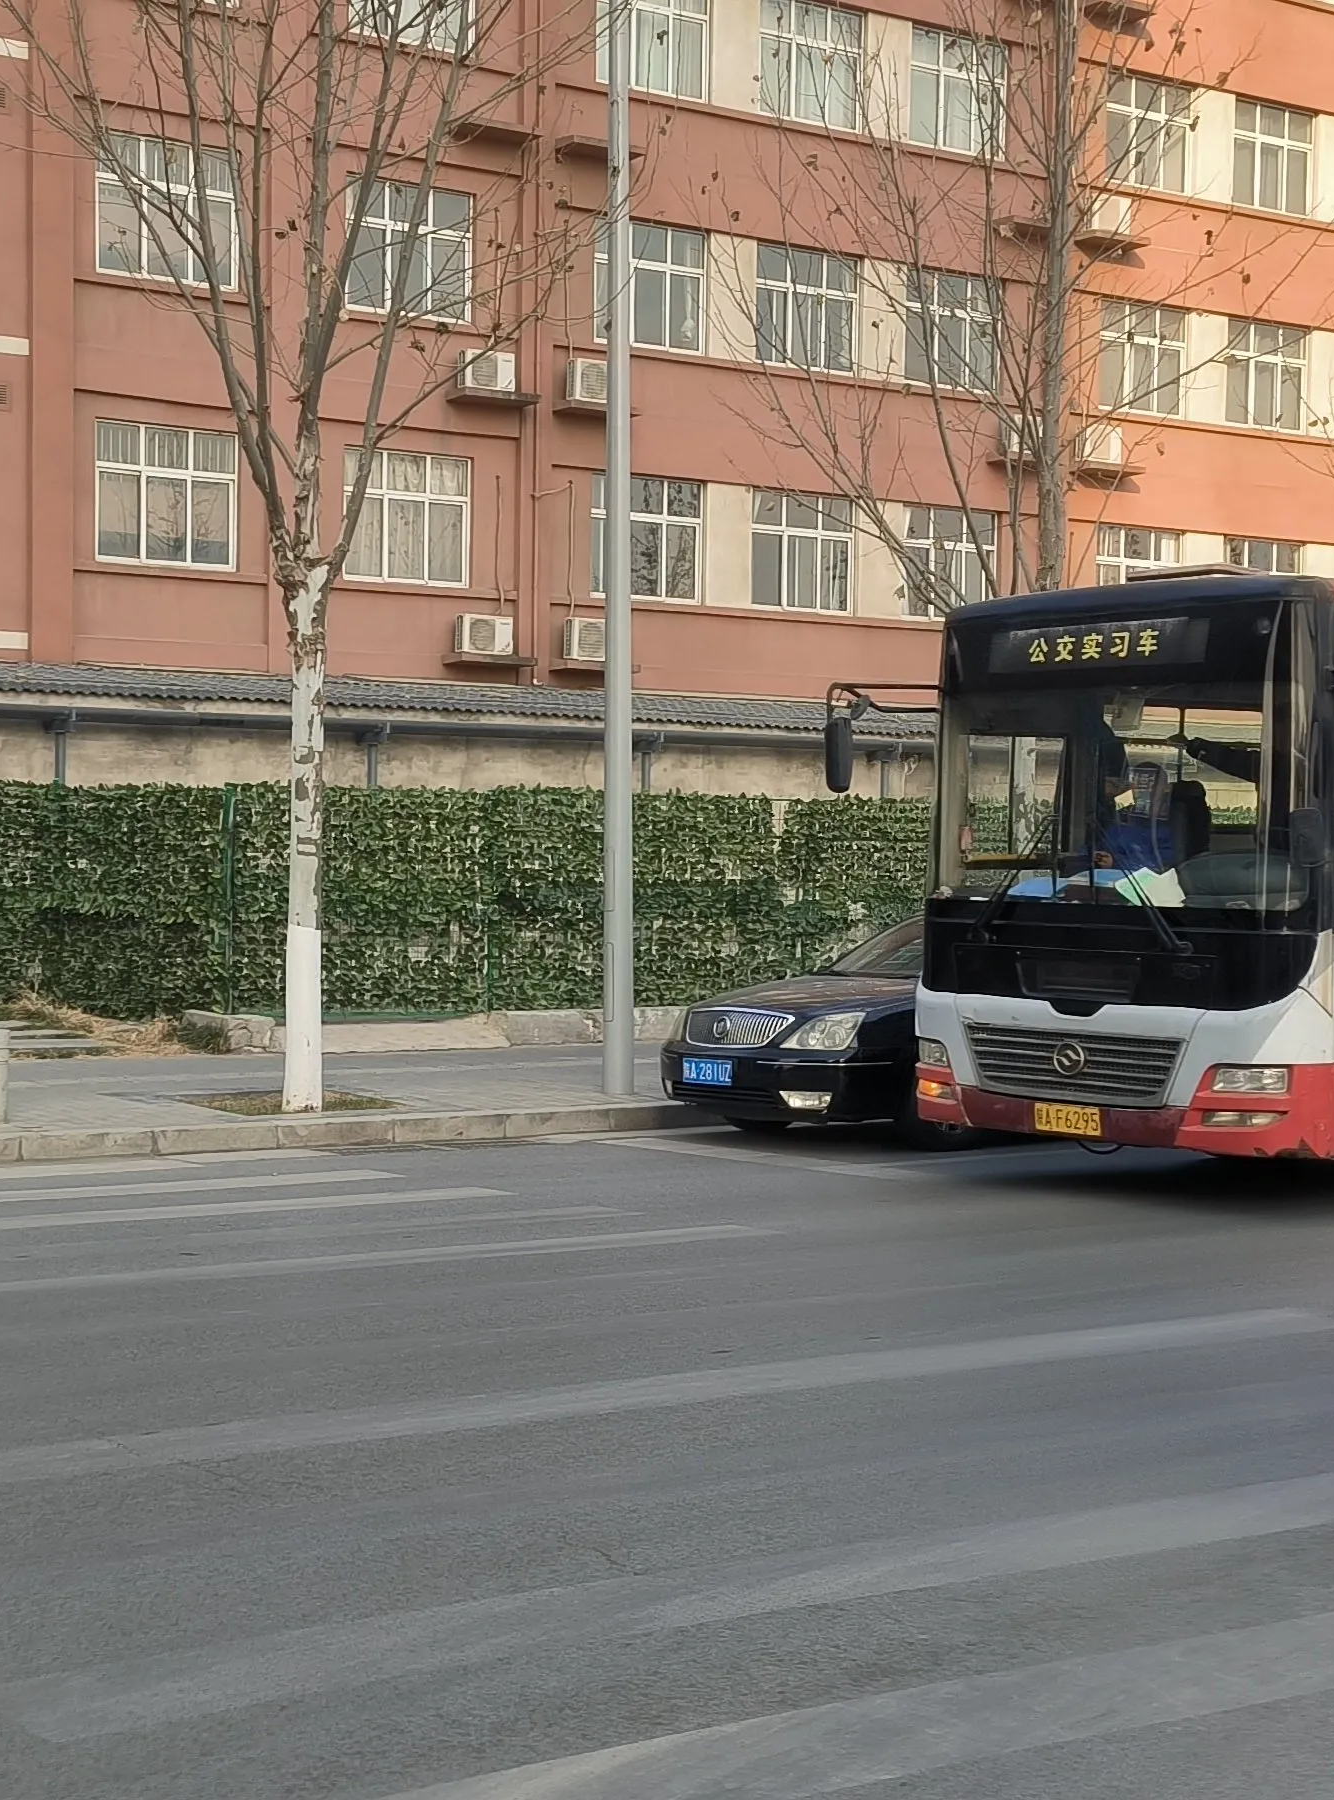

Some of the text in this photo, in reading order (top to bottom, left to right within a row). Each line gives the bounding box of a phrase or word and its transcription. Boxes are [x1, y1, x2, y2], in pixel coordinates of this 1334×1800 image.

[1028, 628, 1159, 663] 公交实习车
